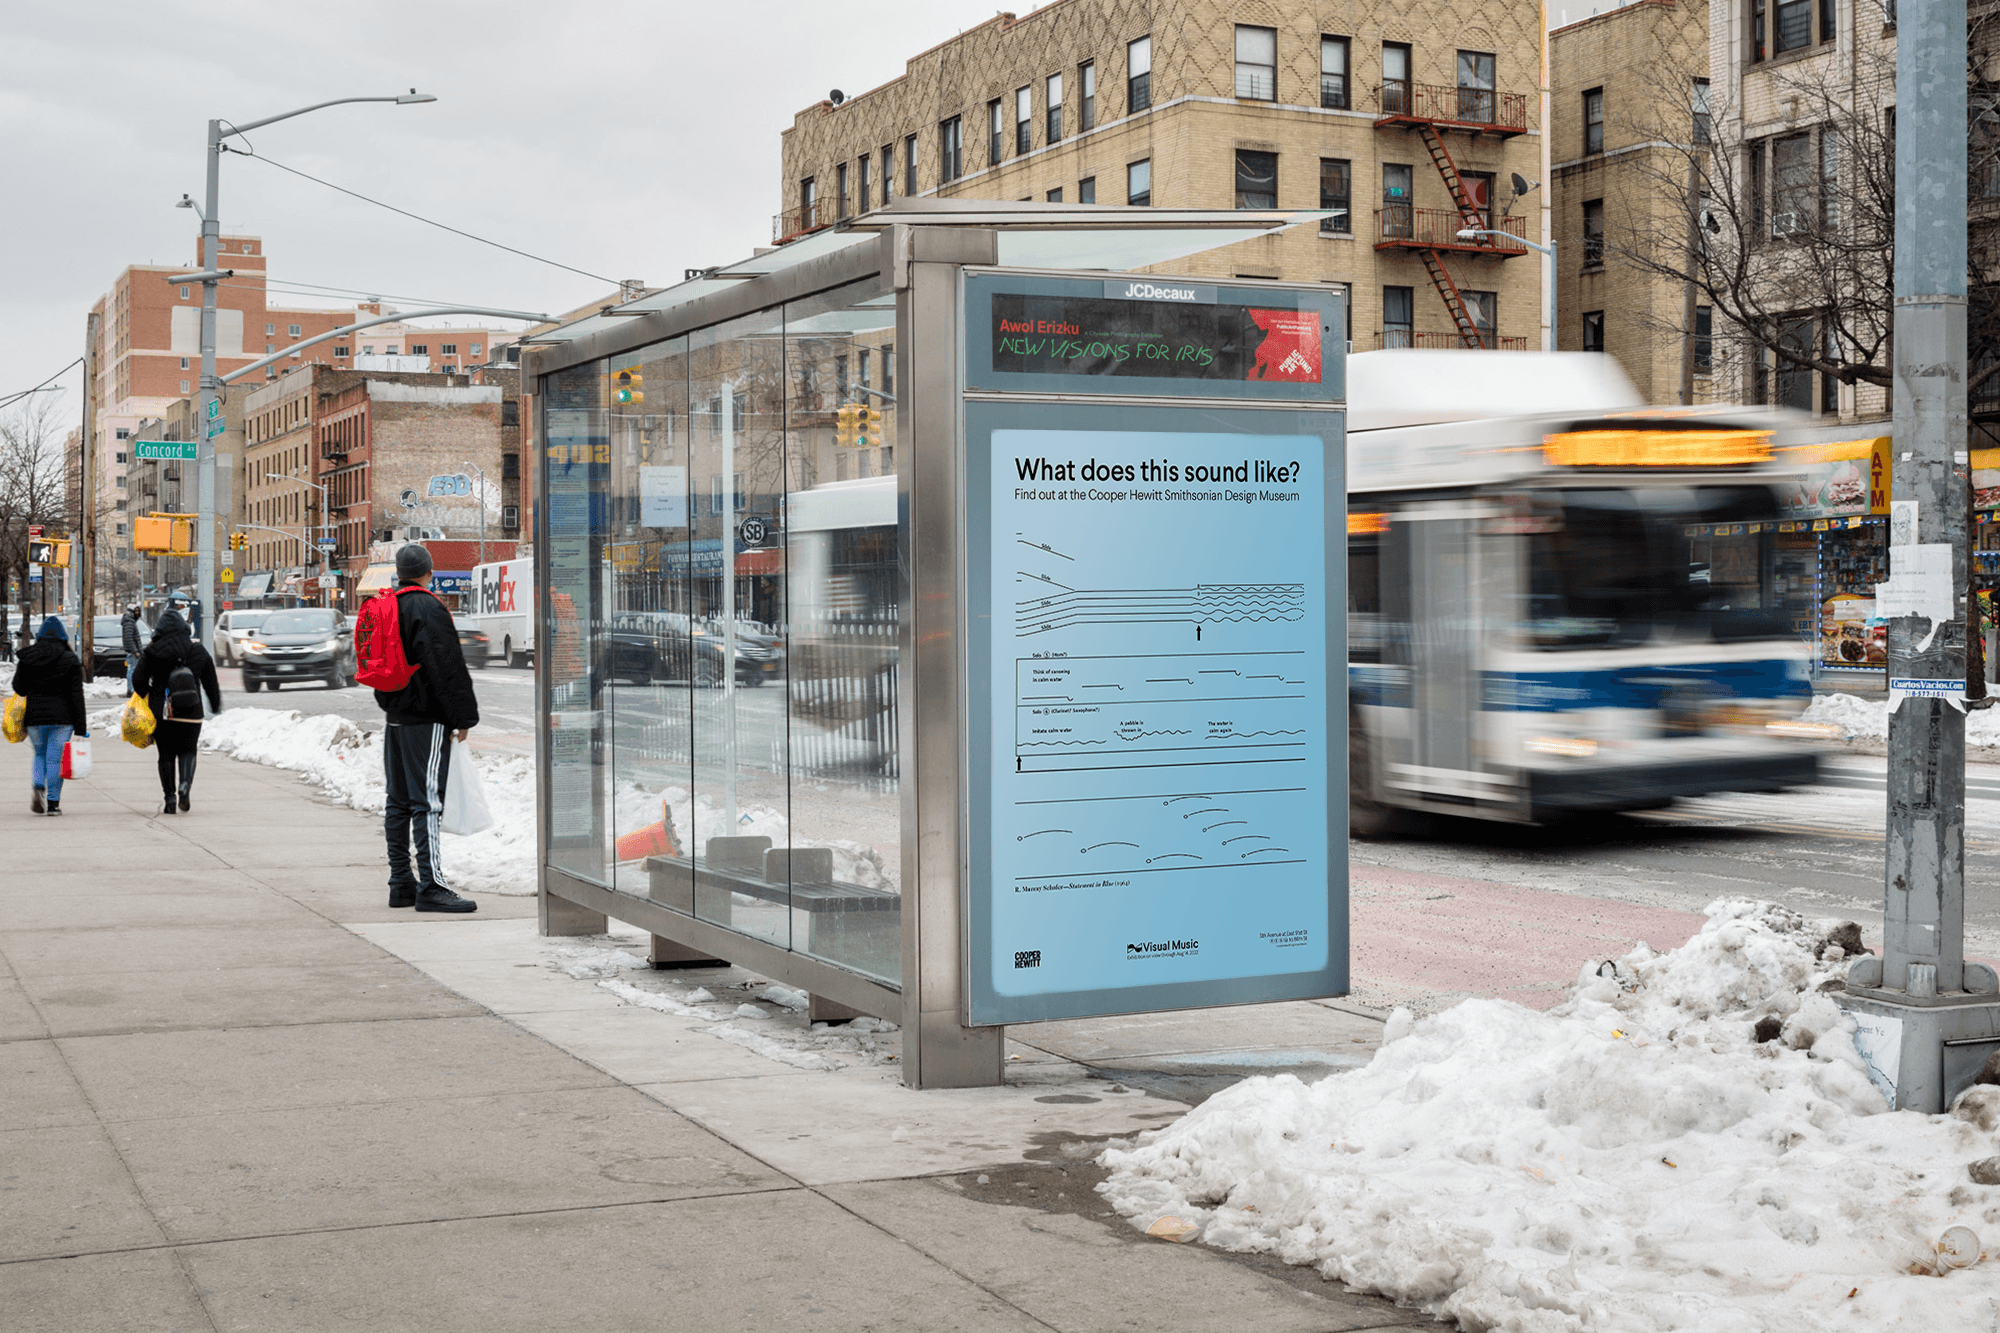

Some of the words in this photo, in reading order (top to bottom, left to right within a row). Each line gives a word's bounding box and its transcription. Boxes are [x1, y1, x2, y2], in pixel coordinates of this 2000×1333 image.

[1125, 283, 1196, 300] JCDecaux
[1000, 319, 1034, 333] Awol
[1037, 320, 1079, 335] Erizku
[999, 337, 1046, 355] NEW
[1051, 339, 1130, 362] VISIONS
[1136, 343, 1169, 360] FOR
[1175, 345, 1213, 366] IRIS
[1278, 349, 1297, 372] PUBLIC
[1287, 359, 1300, 374] ART
[1296, 353, 1312, 374] FUND
[138, 443, 183, 457] Concord
[1015, 457, 1075, 481] What
[1081, 458, 1135, 481] does
[1140, 459, 1179, 482] this
[1184, 460, 1248, 482] sound
[1255, 460, 1300, 483] like?
[1871, 452, 1884, 507] ATM
[1014, 488, 1036, 500] Find
[1038, 490, 1056, 500] out
[1057, 490, 1068, 500] at
[1070, 489, 1086, 500] the
[1088, 489, 1127, 503] Cooper
[1129, 489, 1163, 501] Hewitt
[1164, 489, 1222, 501] Smithsonian
[1225, 490, 1257, 504] Design
[1259, 490, 1300, 501] Museum
[480, 565, 516, 614] FedEx
[1893, 680, 1964, 690] CuartosVacios.Com
[1143, 940, 1170, 952] Visual
[1172, 938, 1199, 950] Music
[1014, 950, 1041, 961] COOPER
[1014, 960, 1041, 969] HEWITT
